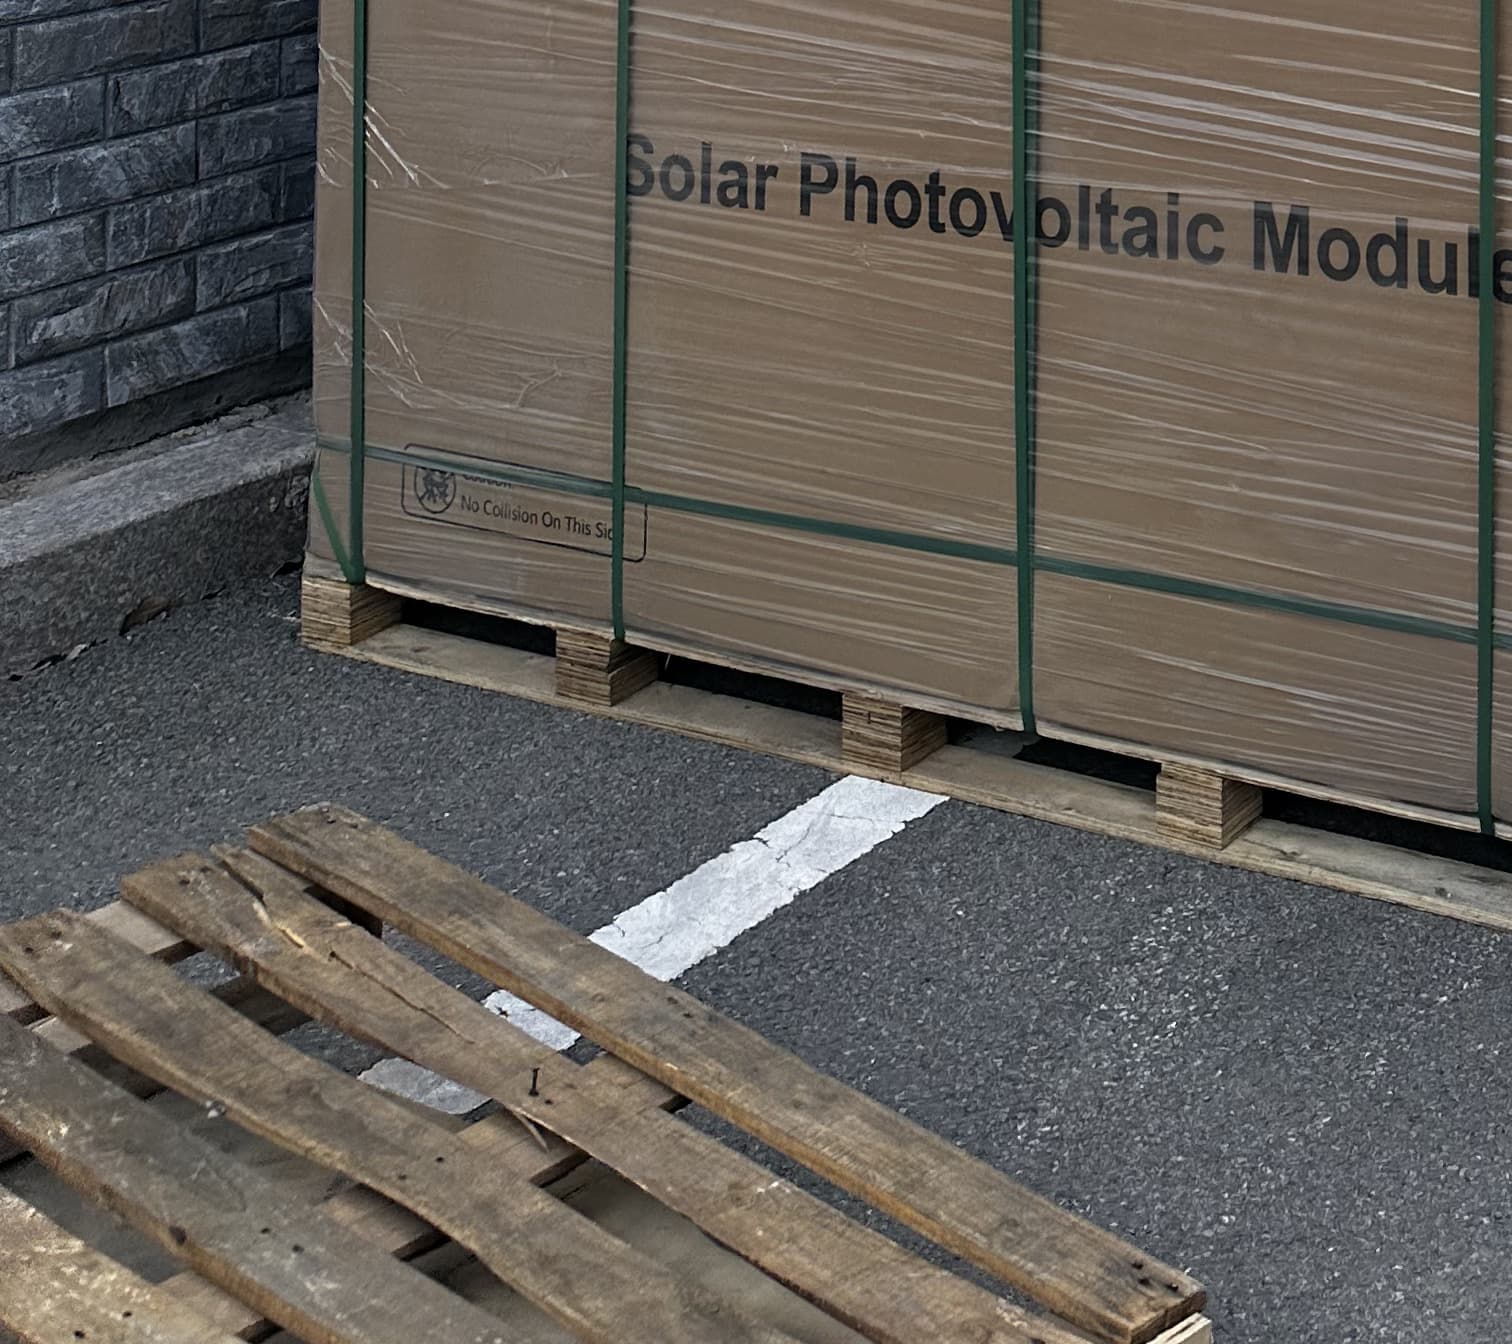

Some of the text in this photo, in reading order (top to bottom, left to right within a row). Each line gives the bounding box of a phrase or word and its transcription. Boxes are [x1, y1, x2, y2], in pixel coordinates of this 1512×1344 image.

[625, 133, 777, 212] Solar
[799, 151, 1225, 265] Photovoltaic
[460, 495, 480, 513] No
[483, 499, 538, 525] Collision
[541, 511, 561, 530] On
[565, 516, 592, 536] This
